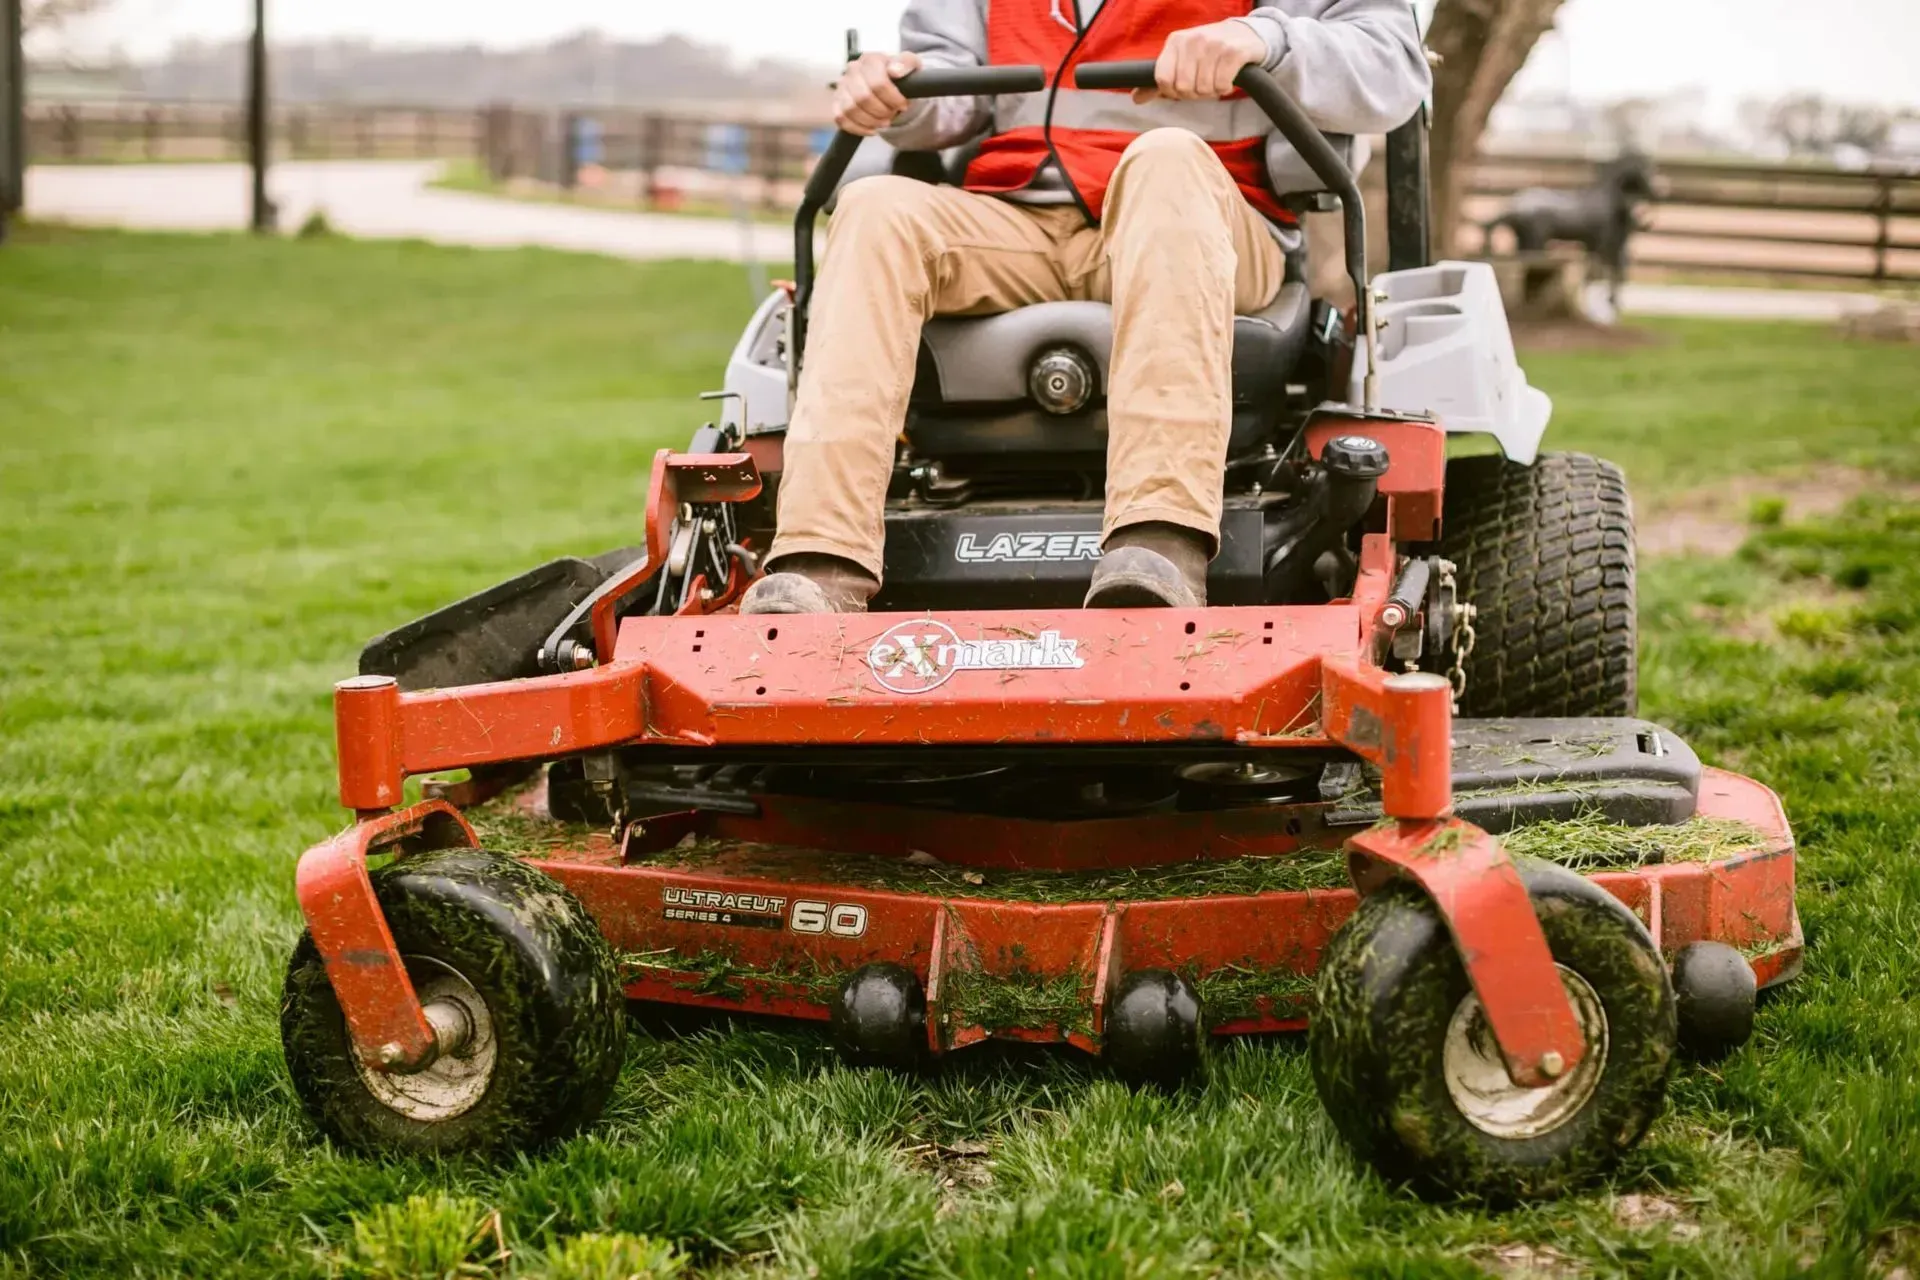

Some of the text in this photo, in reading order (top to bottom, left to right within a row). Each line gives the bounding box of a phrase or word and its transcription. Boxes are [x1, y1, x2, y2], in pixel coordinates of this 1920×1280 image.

[956, 532, 1103, 562] LAZER
[664, 888, 786, 913] ULTRACUT
[664, 908, 732, 923] SERIES 4
[791, 899, 868, 938] 60
